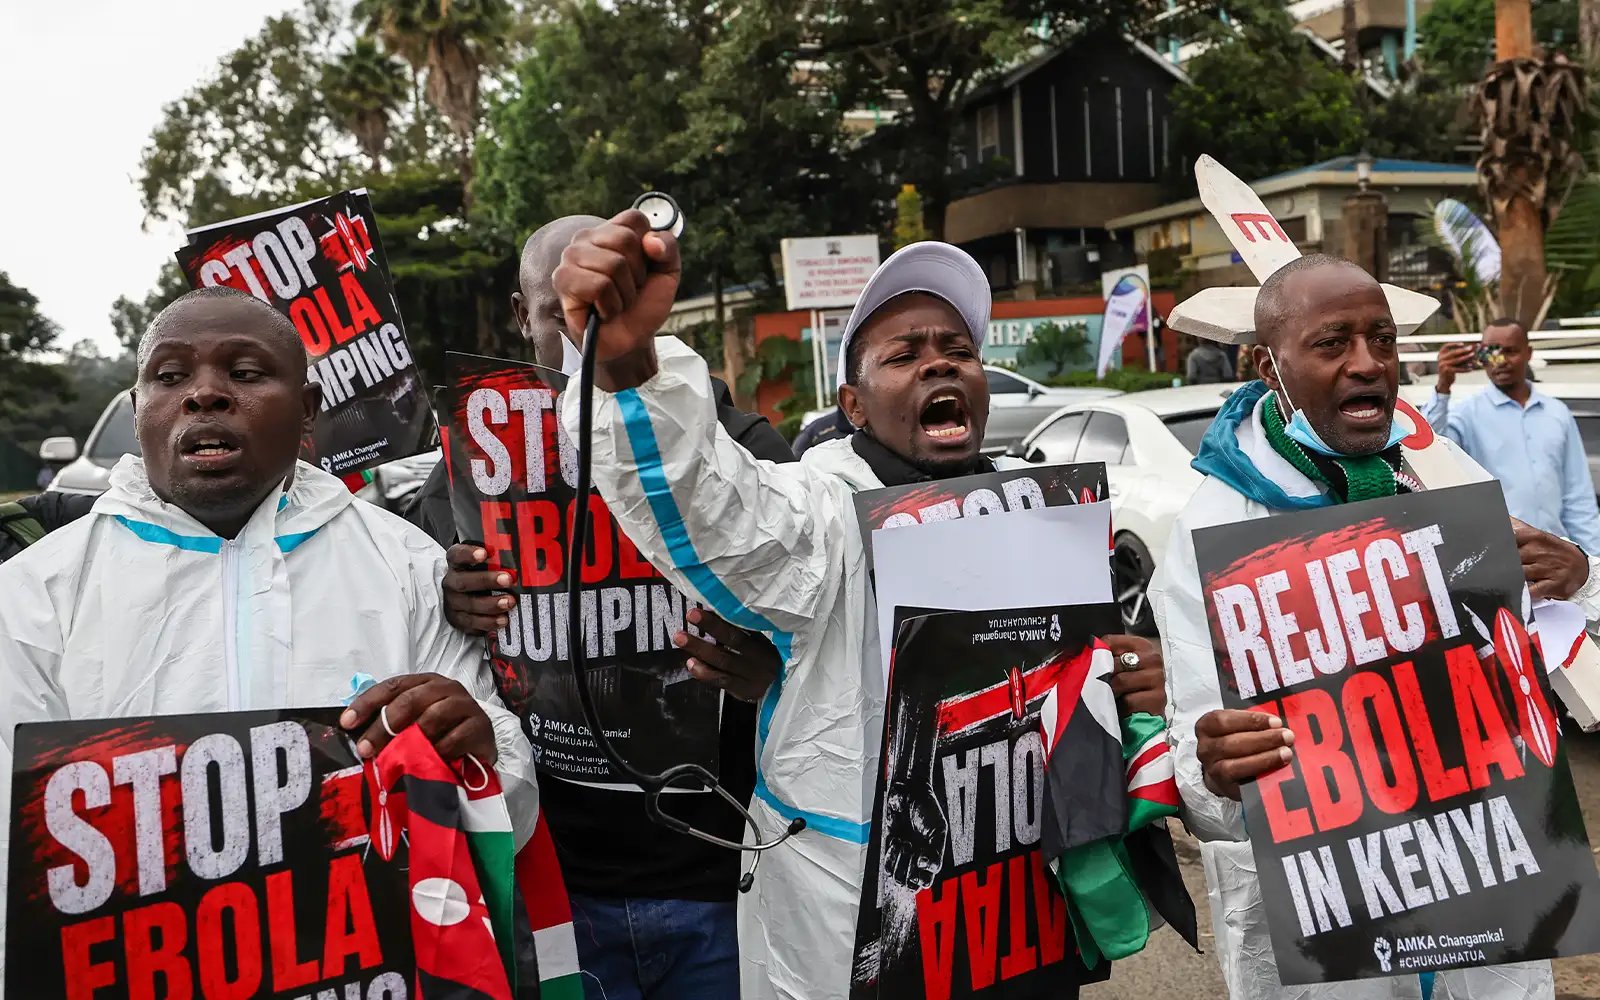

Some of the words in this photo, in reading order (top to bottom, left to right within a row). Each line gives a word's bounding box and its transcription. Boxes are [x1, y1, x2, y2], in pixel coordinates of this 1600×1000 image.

[289, 270, 383, 357] OLA
[307, 322, 414, 413] MPING
[332, 449, 355, 464] AMKA
[354, 437, 389, 456] Changamka!
[335, 451, 380, 471] #CHUKUAHATUA
[480, 494, 664, 588] EBOL
[972, 629, 1017, 645] Changamka!
[988, 616, 1047, 629] #CHUKUAHATUA
[1019, 628, 1047, 641] AMKA
[1212, 524, 1461, 700] REJECT
[544, 719, 575, 734] AMKA
[545, 759, 610, 775] #CHUKUAHATUA
[1245, 643, 1525, 844] EBOLA
[43, 720, 312, 914] STOP
[942, 730, 1045, 867] OLA
[1281, 845, 1353, 938] IN
[1348, 795, 1541, 919] KENYA
[61, 853, 383, 1000] EBOLA
[915, 850, 1067, 1000] ATAA
[1396, 934, 1437, 953] AMKA
[1438, 927, 1505, 948] Changamka!
[1399, 949, 1486, 969] #CHUKUAHATUA
